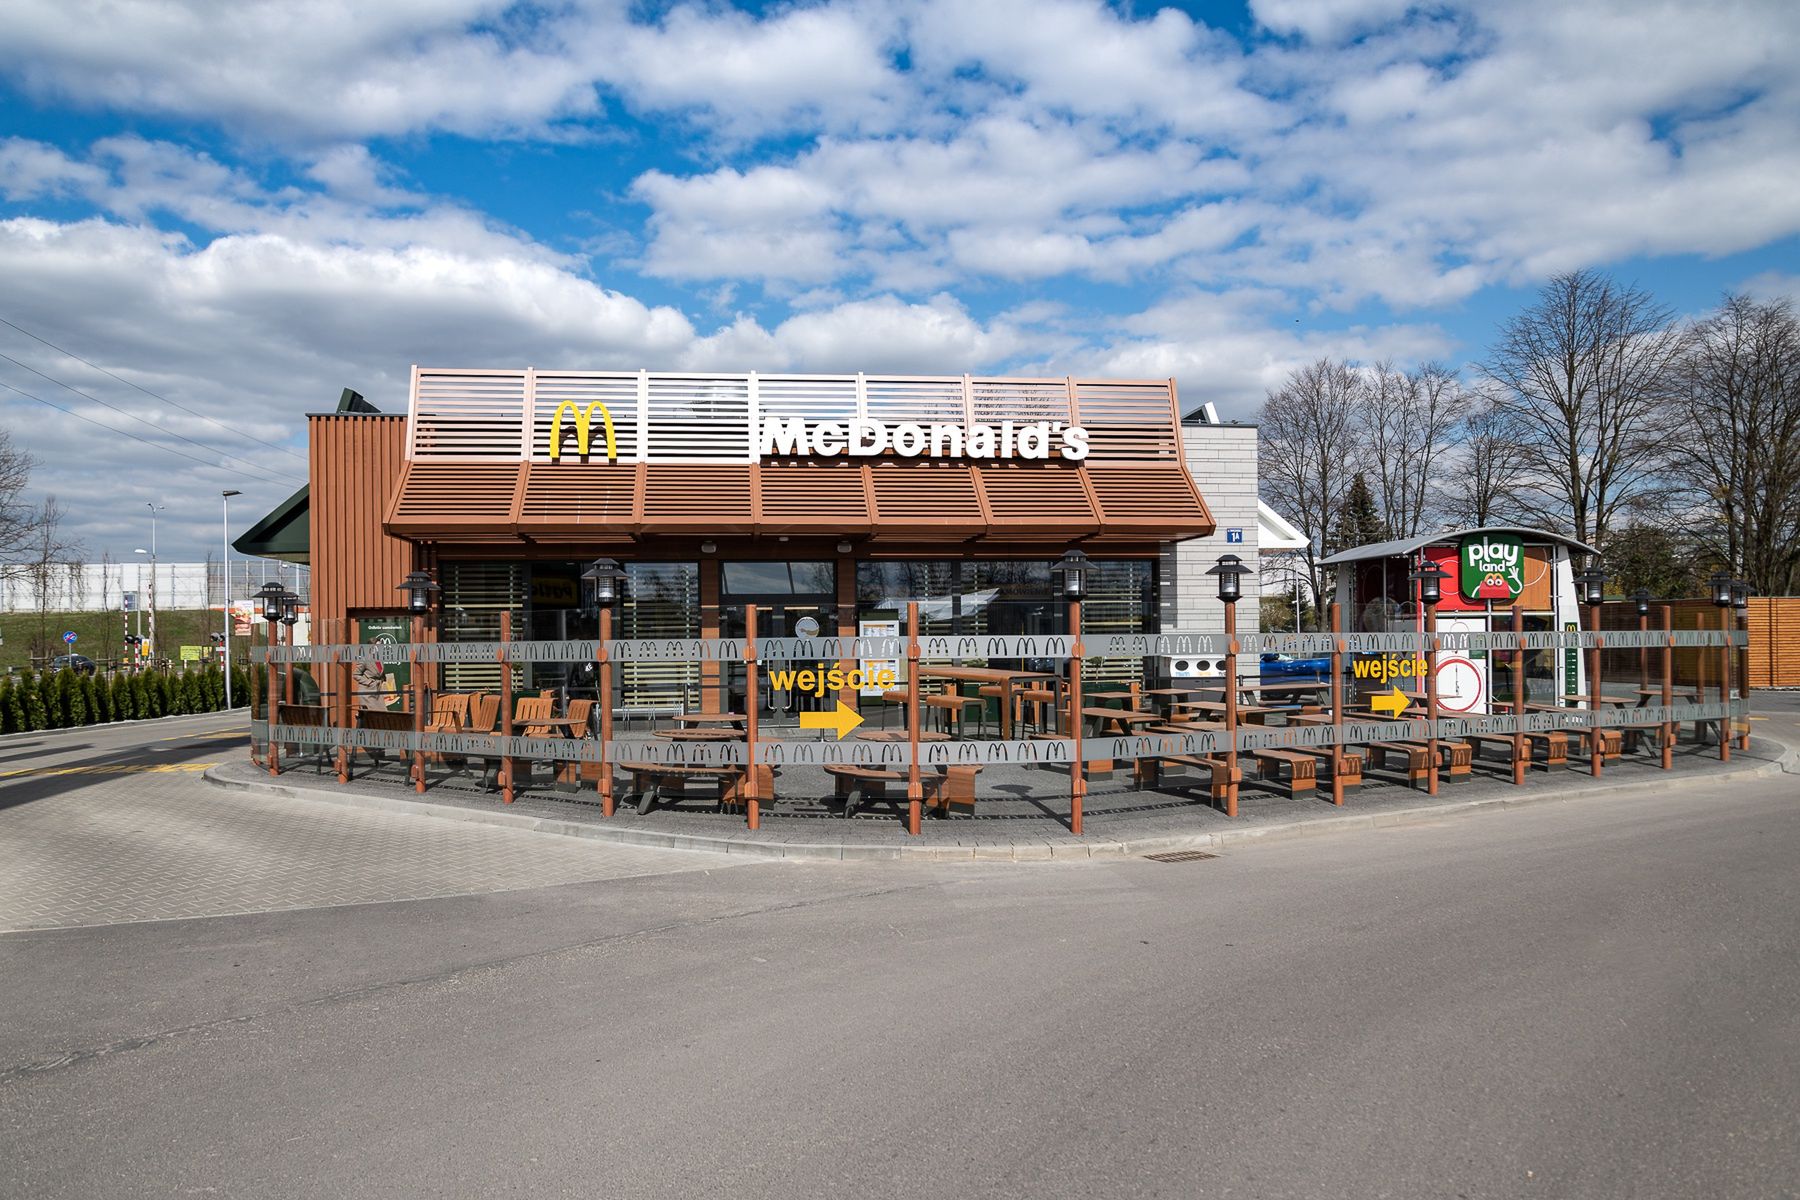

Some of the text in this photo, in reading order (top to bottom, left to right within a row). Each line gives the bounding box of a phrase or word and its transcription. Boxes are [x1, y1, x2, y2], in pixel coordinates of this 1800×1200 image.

[761, 417, 1090, 461] McDonald's
[1468, 536, 1519, 567] play
[1479, 560, 1506, 572] land
[769, 662, 895, 698] wejście
[1352, 653, 1428, 684] wejście
